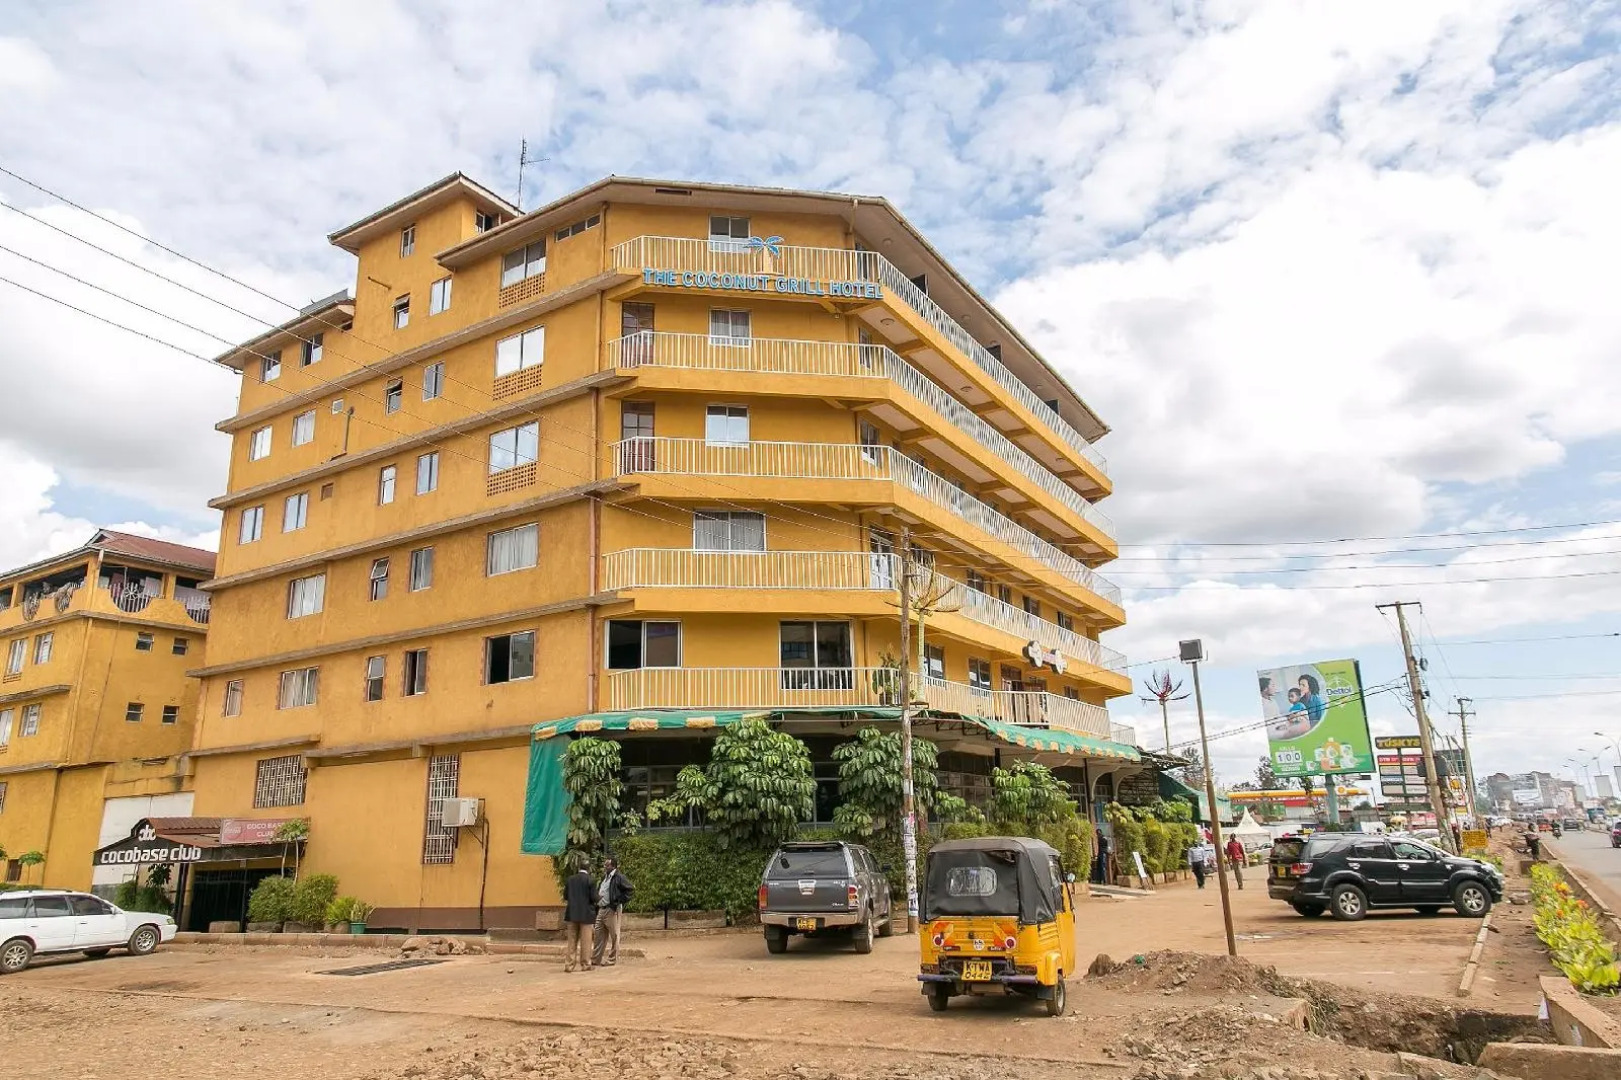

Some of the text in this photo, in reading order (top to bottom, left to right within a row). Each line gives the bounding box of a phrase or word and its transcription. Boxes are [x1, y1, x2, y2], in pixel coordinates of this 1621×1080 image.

[642, 267, 884, 299] THE COCONUT GRILL HOTEL
[1278, 752, 1300, 761] 100
[101, 844, 200, 863] cocobase club
